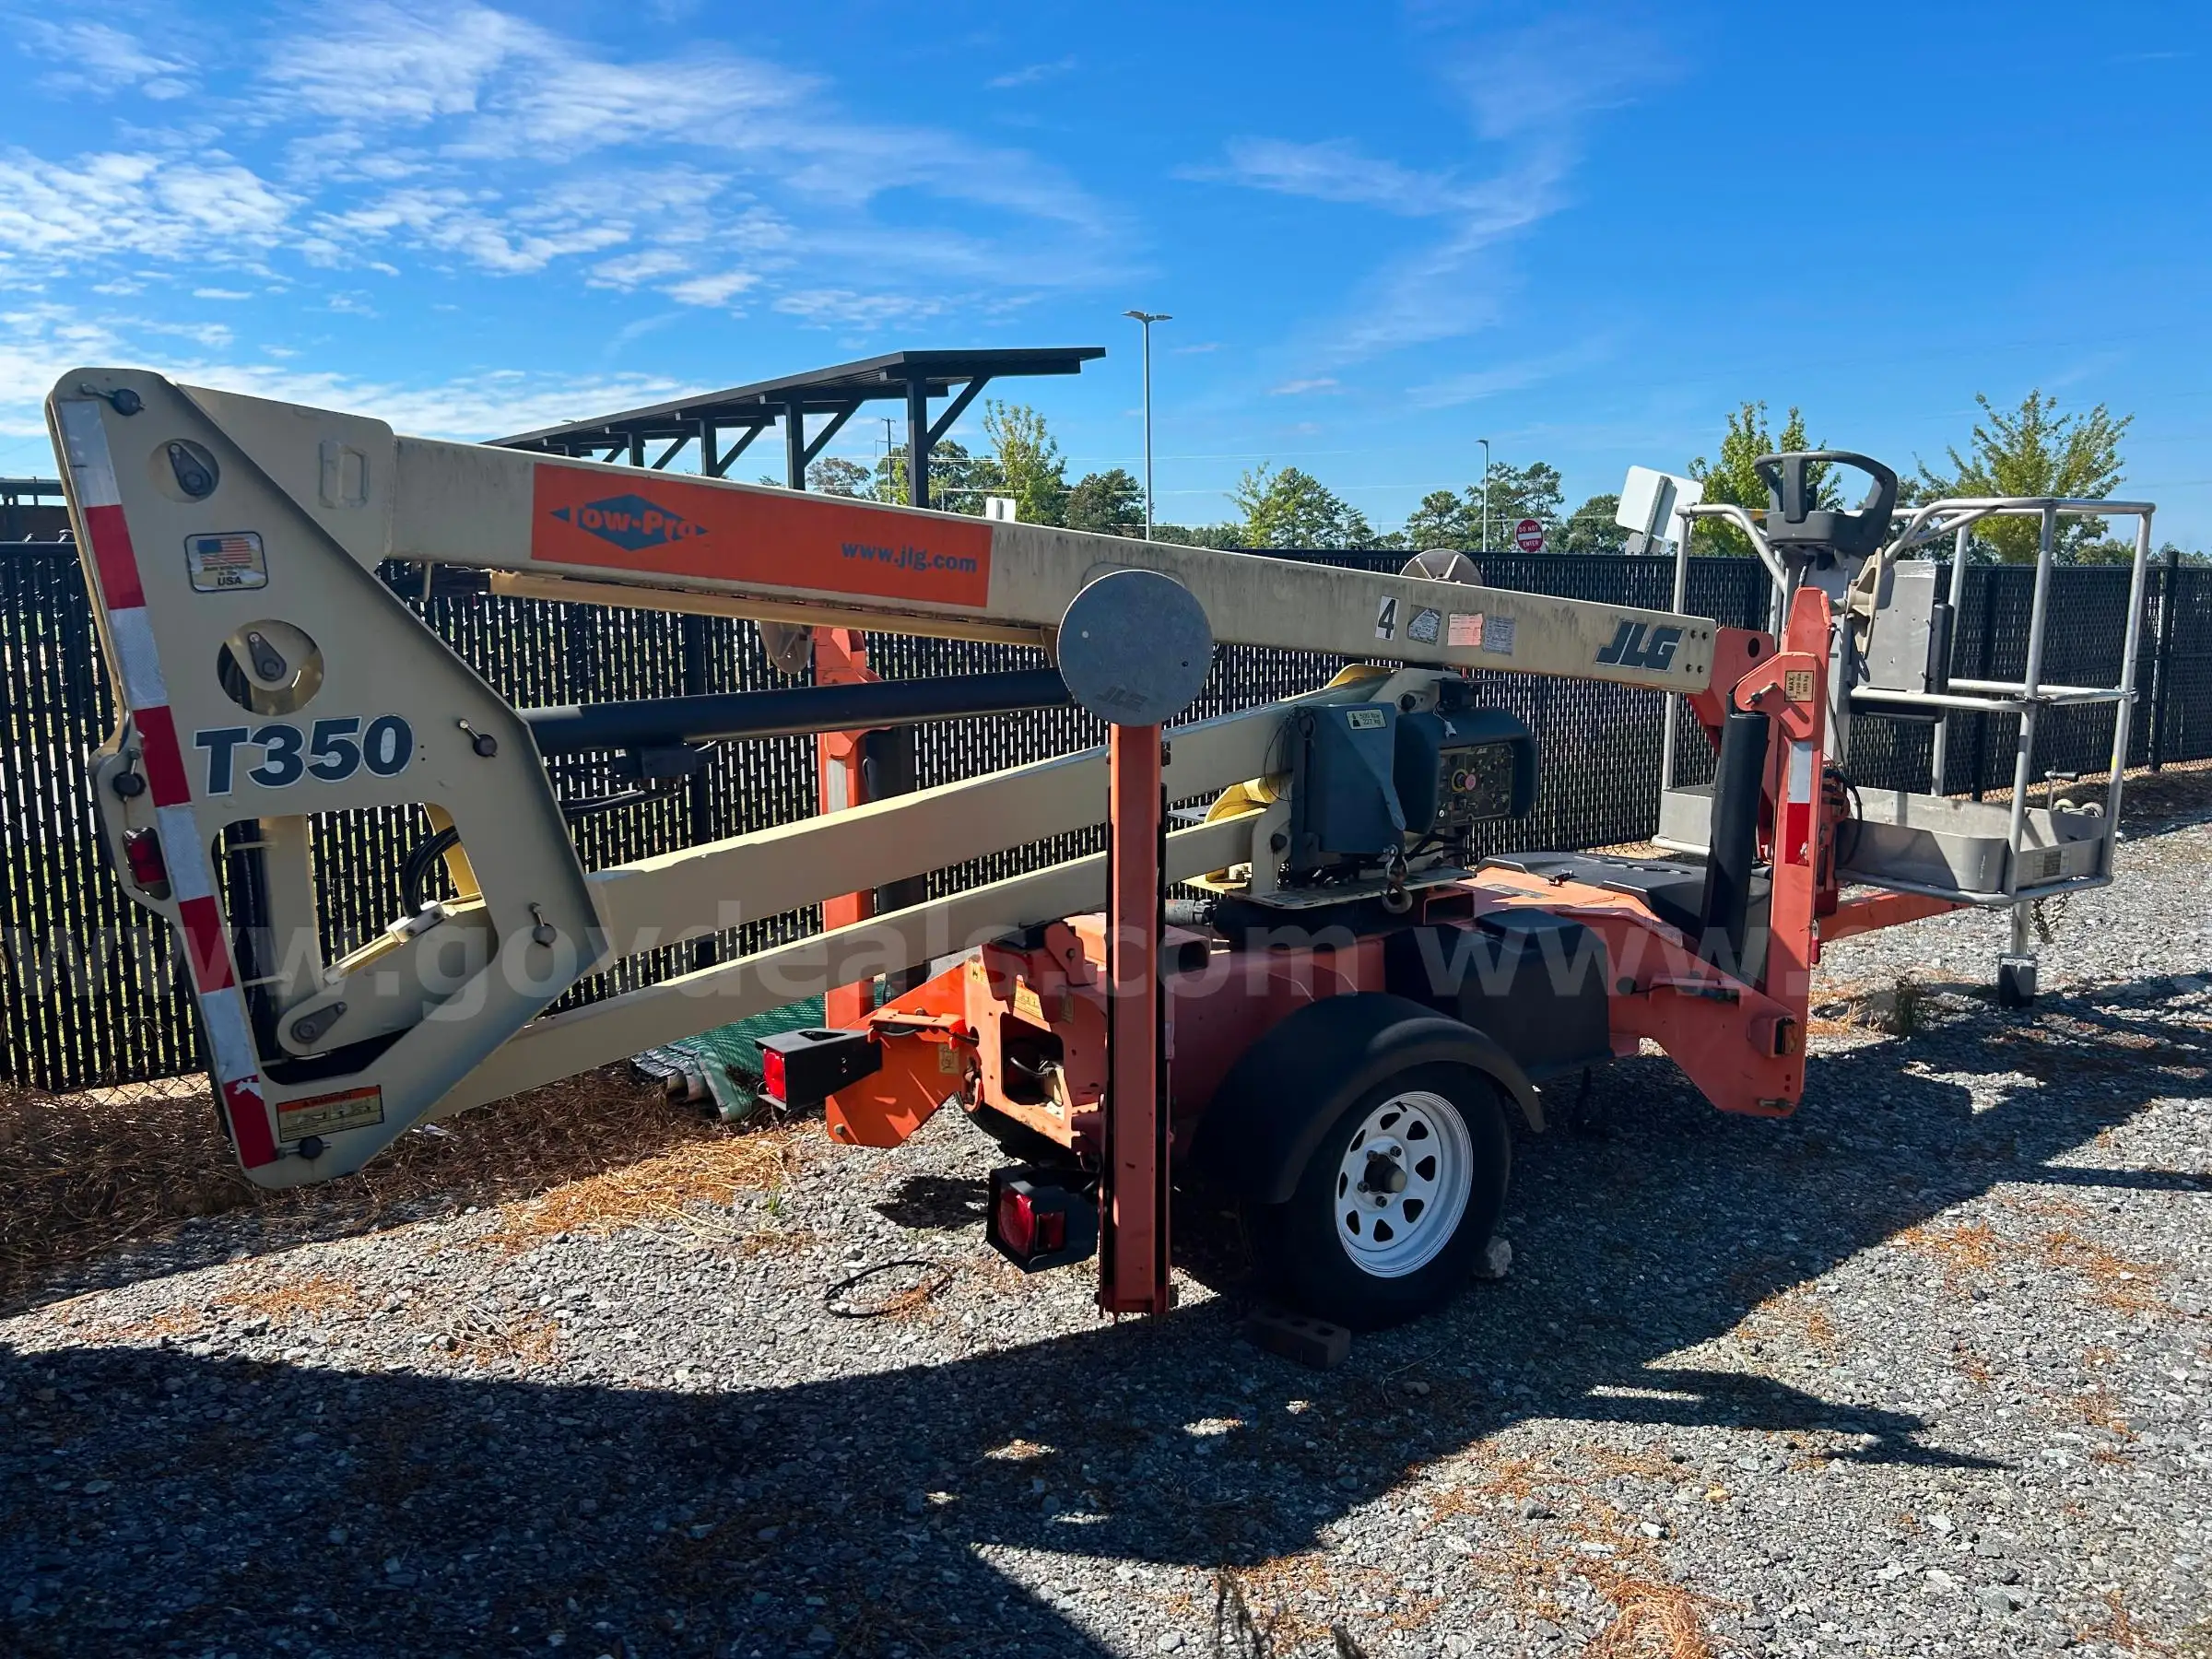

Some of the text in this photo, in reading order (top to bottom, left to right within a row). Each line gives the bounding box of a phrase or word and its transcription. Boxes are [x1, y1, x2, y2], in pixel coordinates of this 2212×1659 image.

[841, 540, 978, 573] www.jlg.com
[218, 576, 242, 586] USA
[1377, 598, 1396, 640] 4
[1594, 618, 1685, 672] JLG
[1095, 686, 1148, 712] JLG
[194, 713, 414, 796] T350
